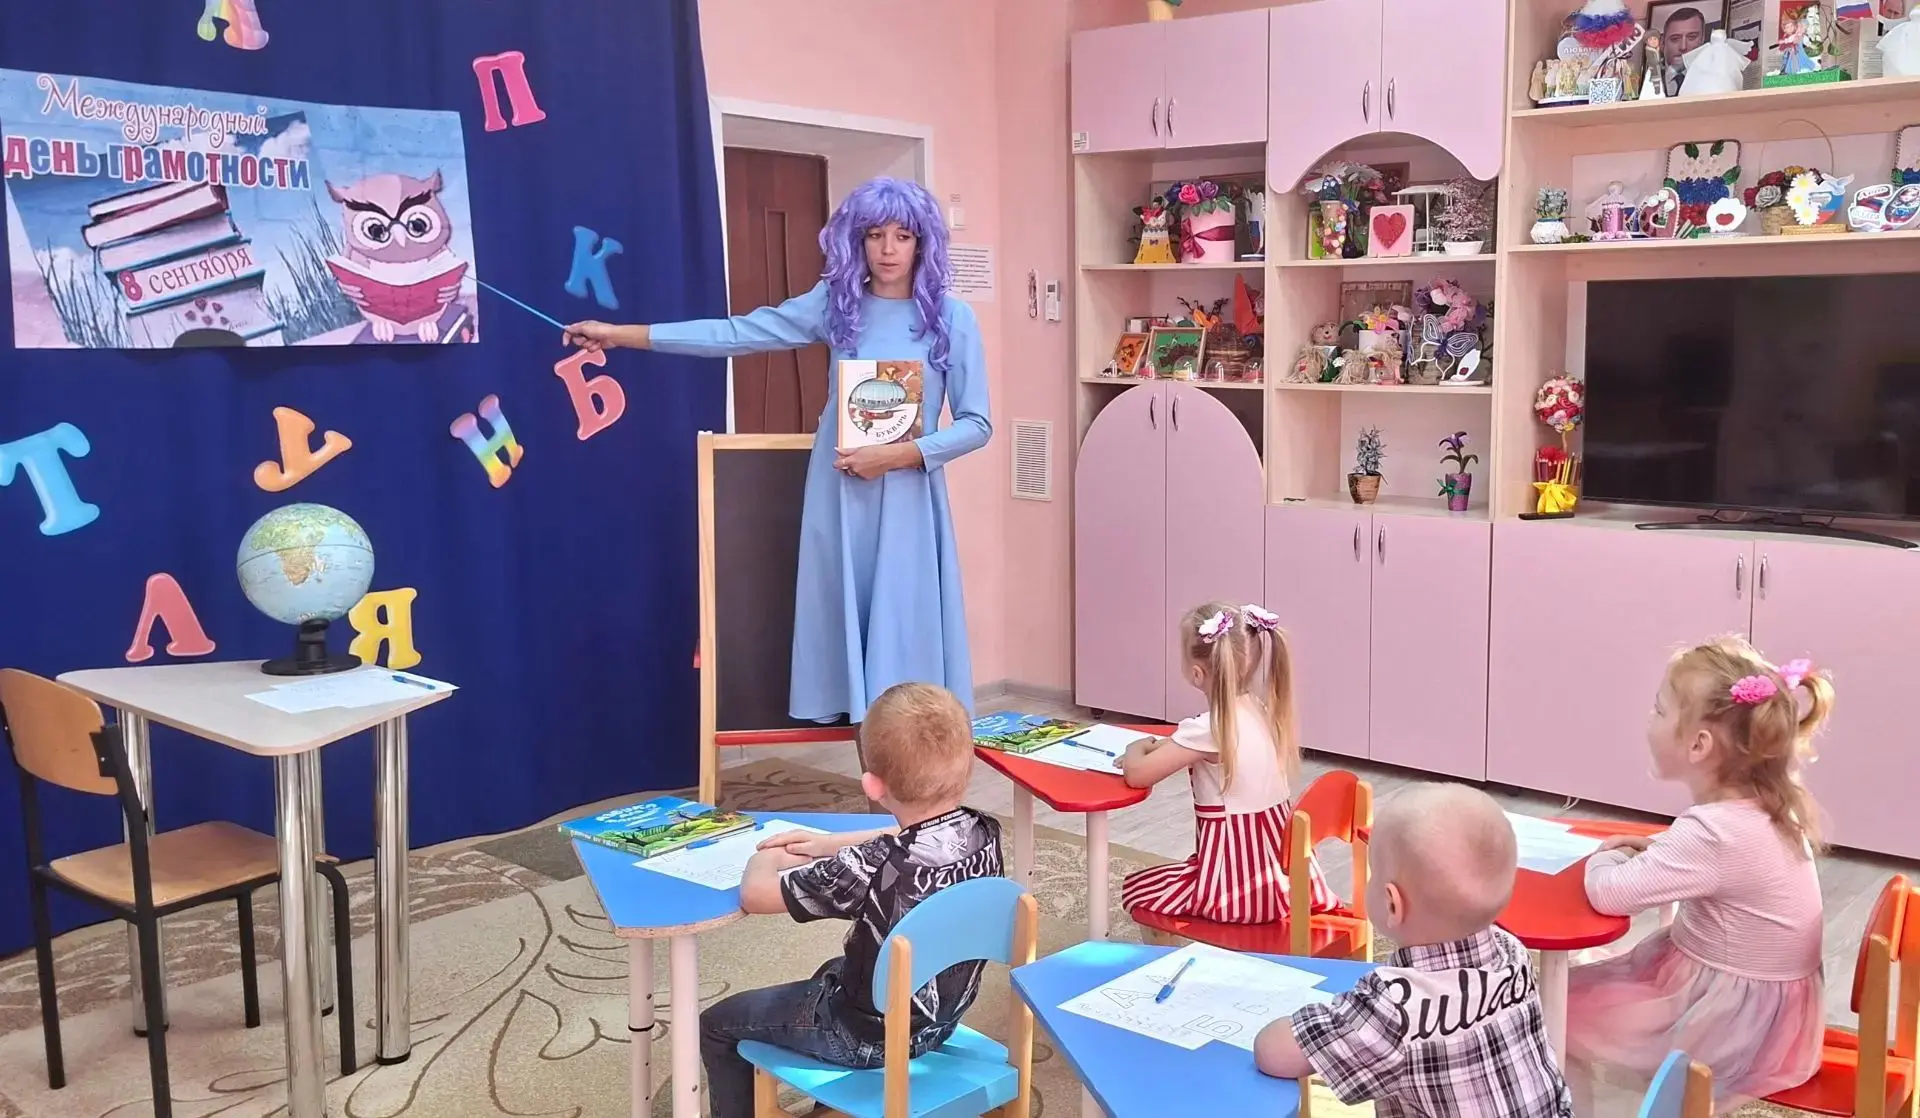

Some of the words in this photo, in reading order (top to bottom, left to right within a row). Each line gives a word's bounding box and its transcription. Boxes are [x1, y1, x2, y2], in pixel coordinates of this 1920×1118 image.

[37, 74, 268, 148] Международный
[472, 50, 546, 131] П
[4, 136, 101, 180] день
[107, 142, 311, 190] грамотности
[118, 270, 143, 301] 8
[149, 247, 253, 294] сентября
[565, 225, 623, 310] К
[554, 348, 626, 440] Б
[876, 414, 907, 438] БУКВАРЬ
[0, 422, 100, 536] Т
[253, 406, 352, 492] У
[450, 394, 524, 488] Н
[126, 573, 216, 662] Л
[348, 587, 422, 670] Я
